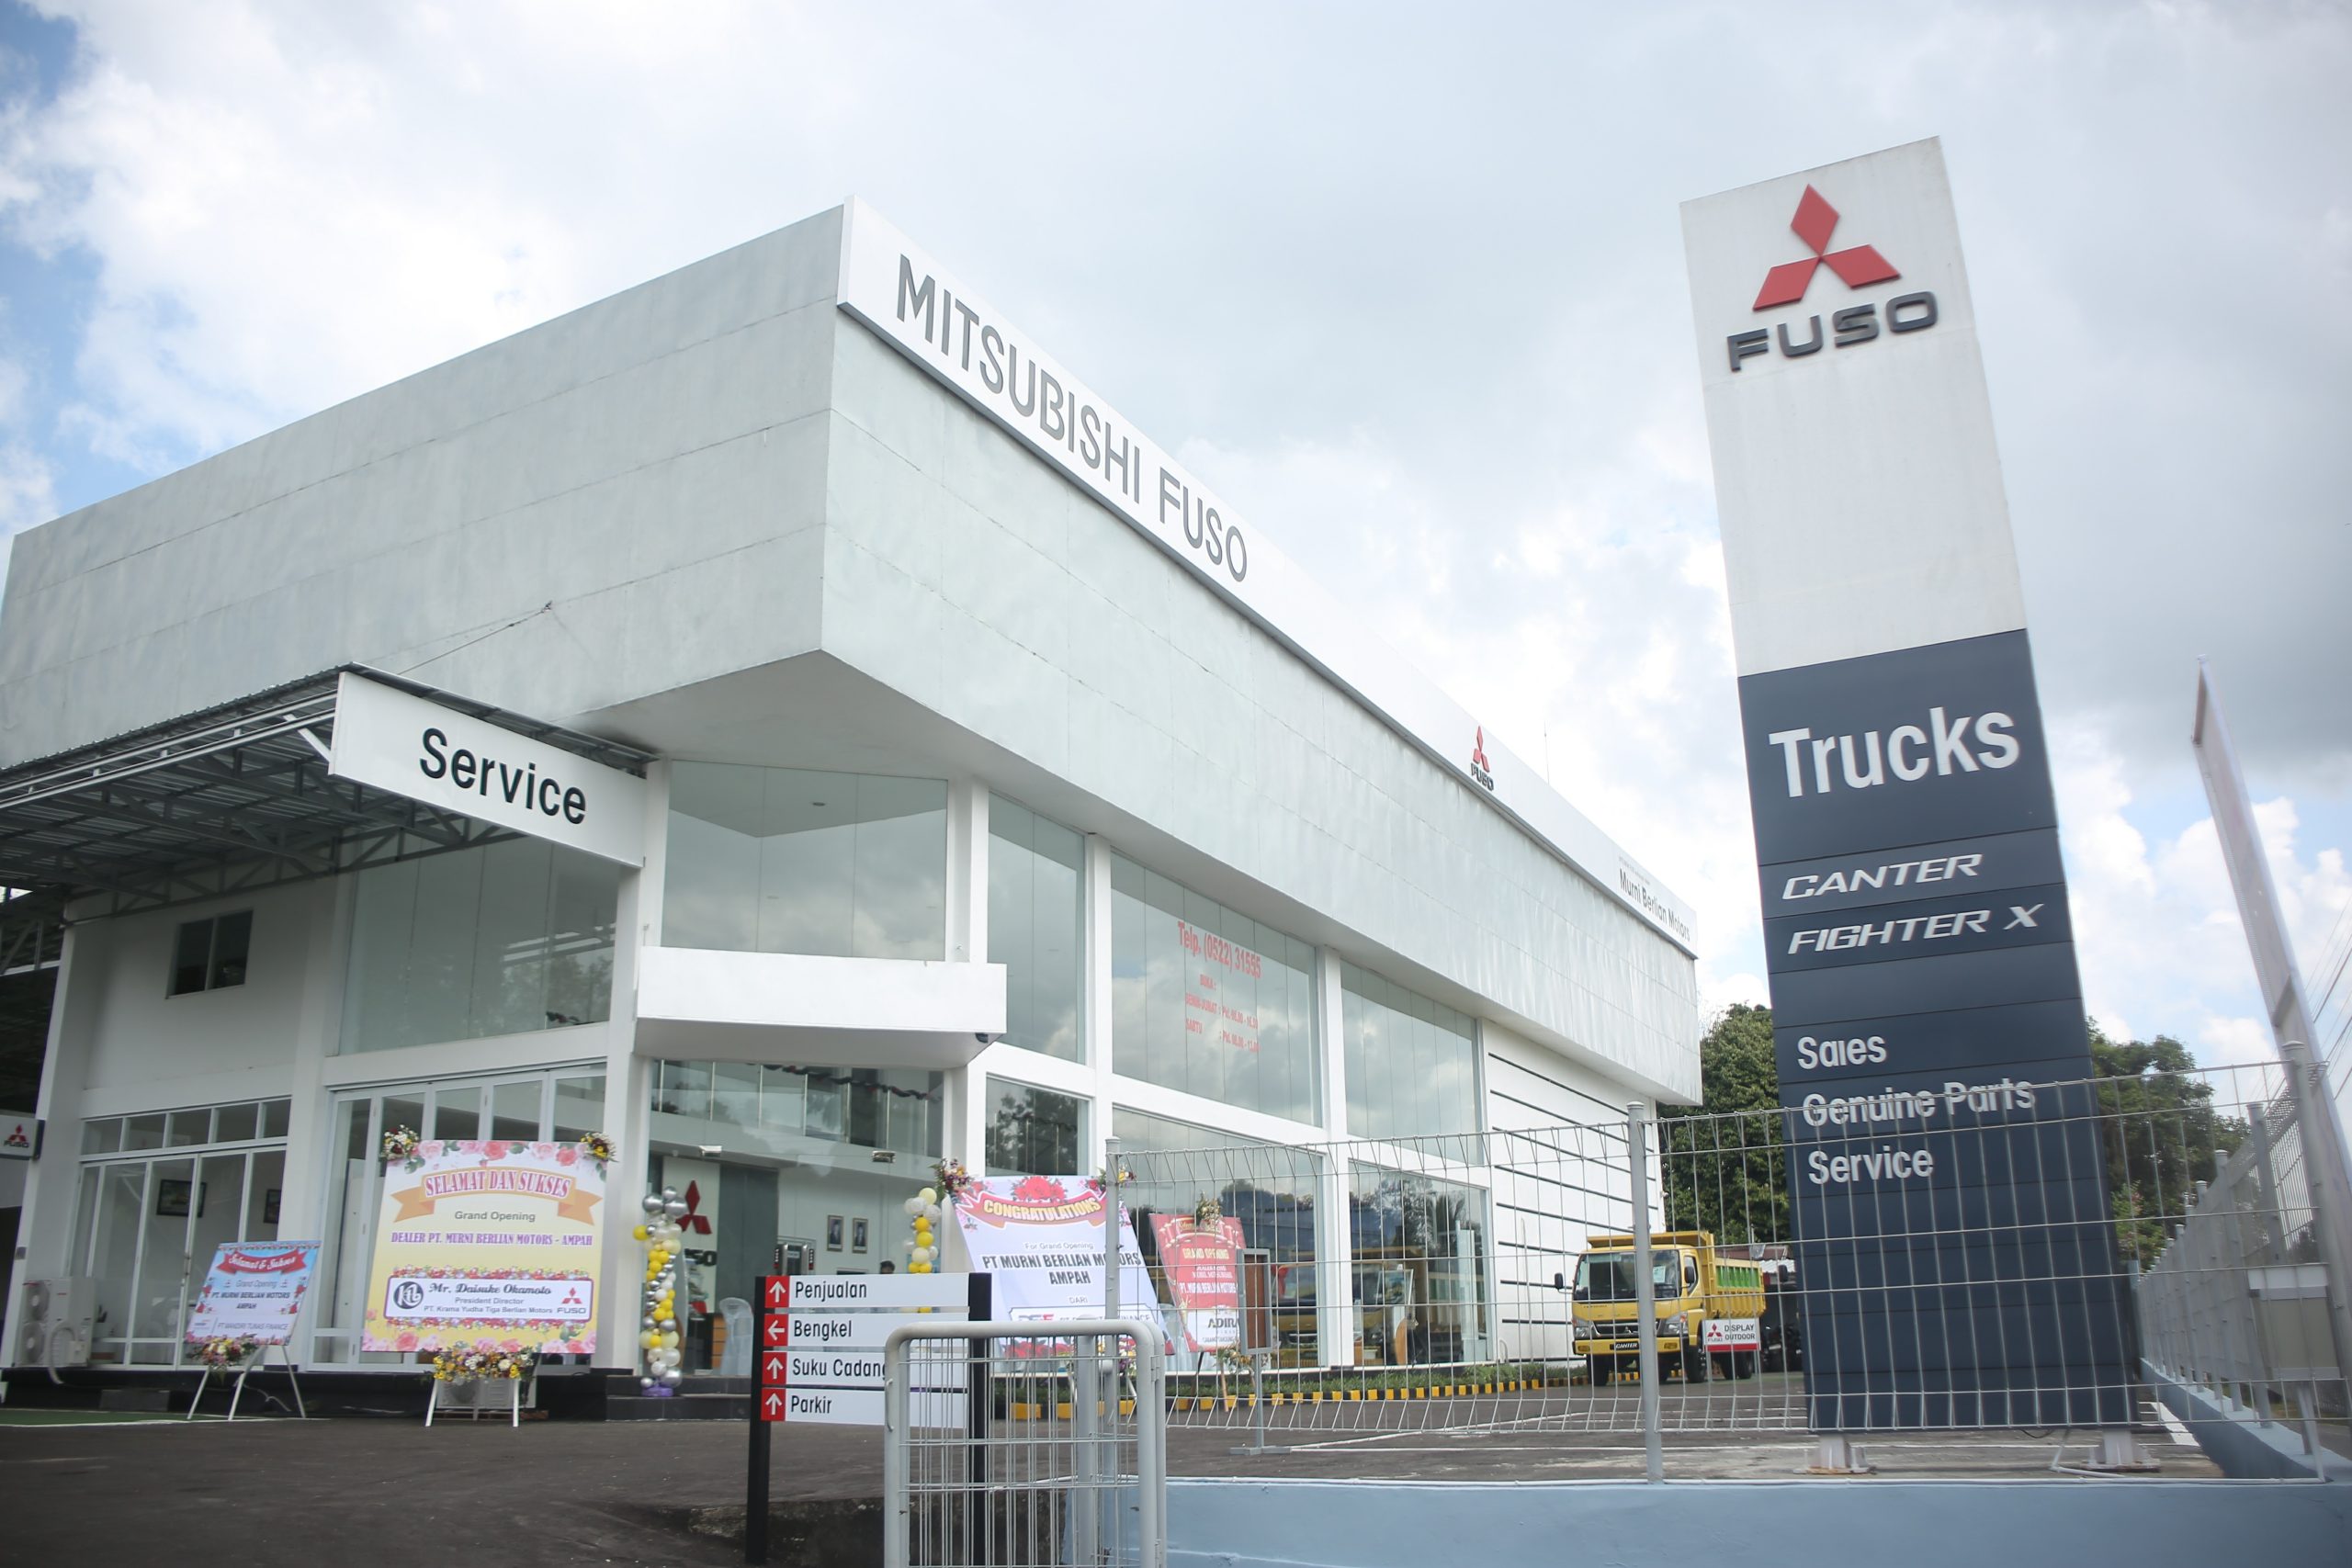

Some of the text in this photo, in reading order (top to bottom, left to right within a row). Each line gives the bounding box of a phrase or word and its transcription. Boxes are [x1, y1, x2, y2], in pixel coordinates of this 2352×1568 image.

[1727, 290, 1939, 372] FUSO
[897, 254, 1248, 582] MITSUBISHI FUSO
[1769, 706, 2019, 797] Trucks
[419, 728, 586, 825] Service
[1471, 763, 1494, 791] FUSO
[1782, 853, 1983, 900] CANTER
[1620, 867, 1642, 904] Murni
[1642, 886, 1668, 924] Berlian
[1668, 908, 1690, 942] Motors
[1788, 903, 2044, 954] FIGHTER X
[1204, 932, 1233, 974] (0522)
[1803, 1077, 2035, 1127] Genuine Parts
[1808, 1145, 1934, 1185] Service
[425, 1170, 571, 1199] SELAMAT DAN SUKSES
[455, 1211, 536, 1223] Grand Opening
[983, 1198, 1101, 1222] CONGRATULATIONS
[391, 1232, 425, 1243] DEALER
[428, 1233, 442, 1244] PT.
[447, 1233, 474, 1244] MURNI
[476, 1233, 514, 1245] BERLIAN
[517, 1234, 552, 1246] MOTORS
[561, 1235, 593, 1246] AMPAH
[1063, 1242, 1094, 1250] Opening
[982, 1256, 999, 1269] PT
[1001, 1255, 1043, 1269] MURNI
[1044, 1254, 1091, 1268] BERLIAN
[429, 1283, 551, 1294] Mr. Daisuke Okamoto
[1049, 1271, 1091, 1284] AMPAH
[455, 1297, 524, 1305] President Director
[795, 1280, 867, 1302] Penjualan
[794, 1320, 852, 1341] Bengkel
[793, 1358, 886, 1381] Suku Cadan
[791, 1395, 831, 1414] Parkir
